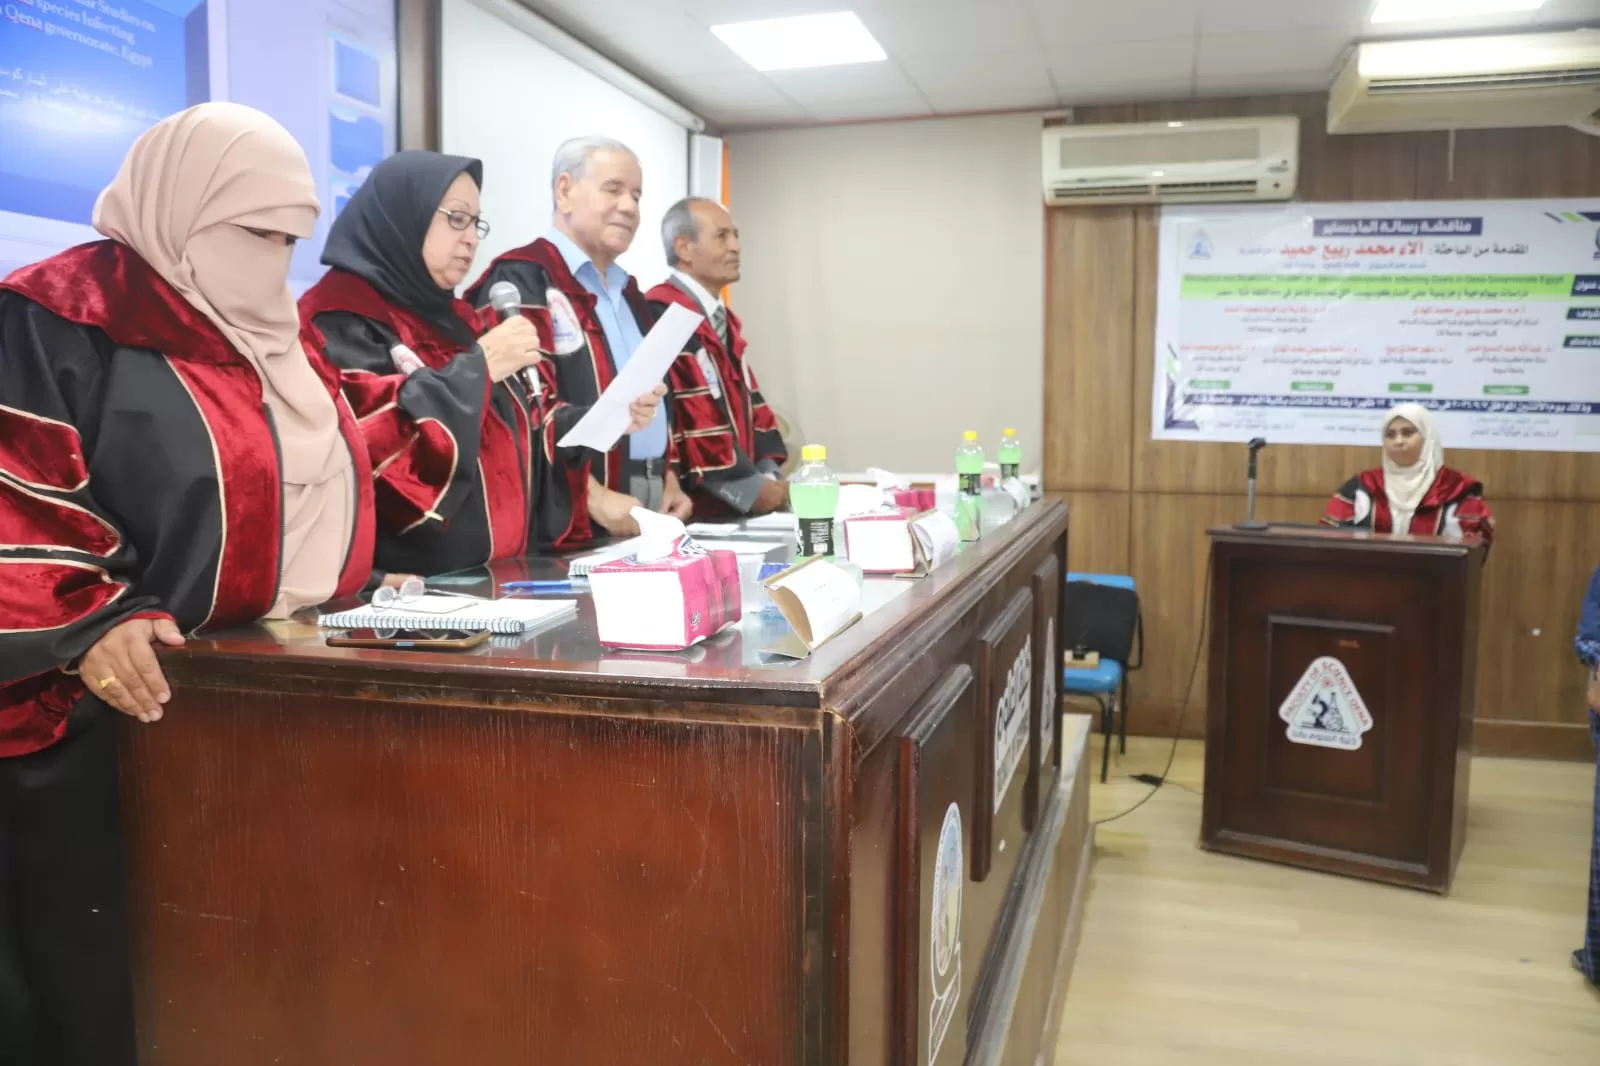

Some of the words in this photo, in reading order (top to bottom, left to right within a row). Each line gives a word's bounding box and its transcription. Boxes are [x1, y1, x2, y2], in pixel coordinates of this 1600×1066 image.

[5, 4, 44, 31] Qena
[1322, 220, 1379, 237] الماجستير
[1380, 220, 1418, 236] رسالة
[1420, 219, 1472, 233] مناقشة
[1355, 243, 1395, 255] محمد
[1473, 246, 1489, 258] من
